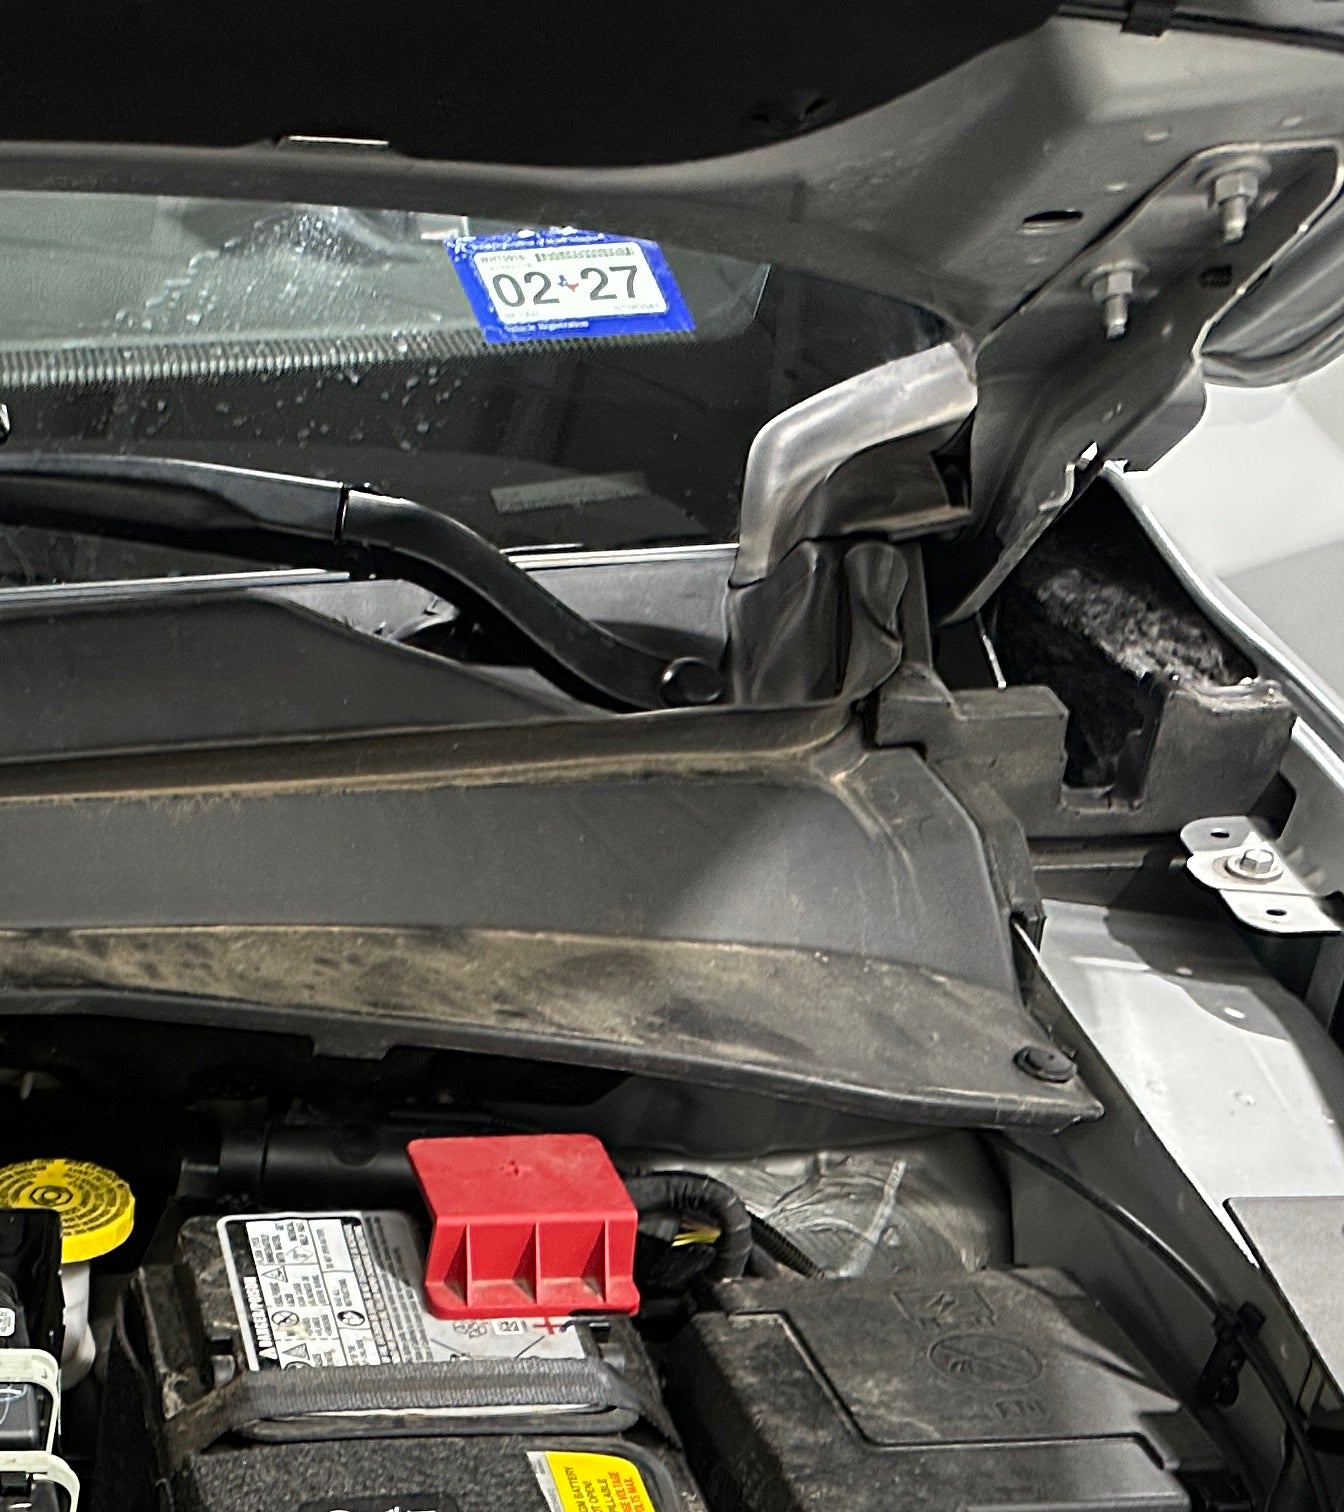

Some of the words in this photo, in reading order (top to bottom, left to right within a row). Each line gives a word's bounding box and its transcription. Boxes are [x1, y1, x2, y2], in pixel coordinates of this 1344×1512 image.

[492, 271, 560, 308] 02
[580, 265, 638, 301] 27
[563, 1466, 584, 1498] BATTERY
